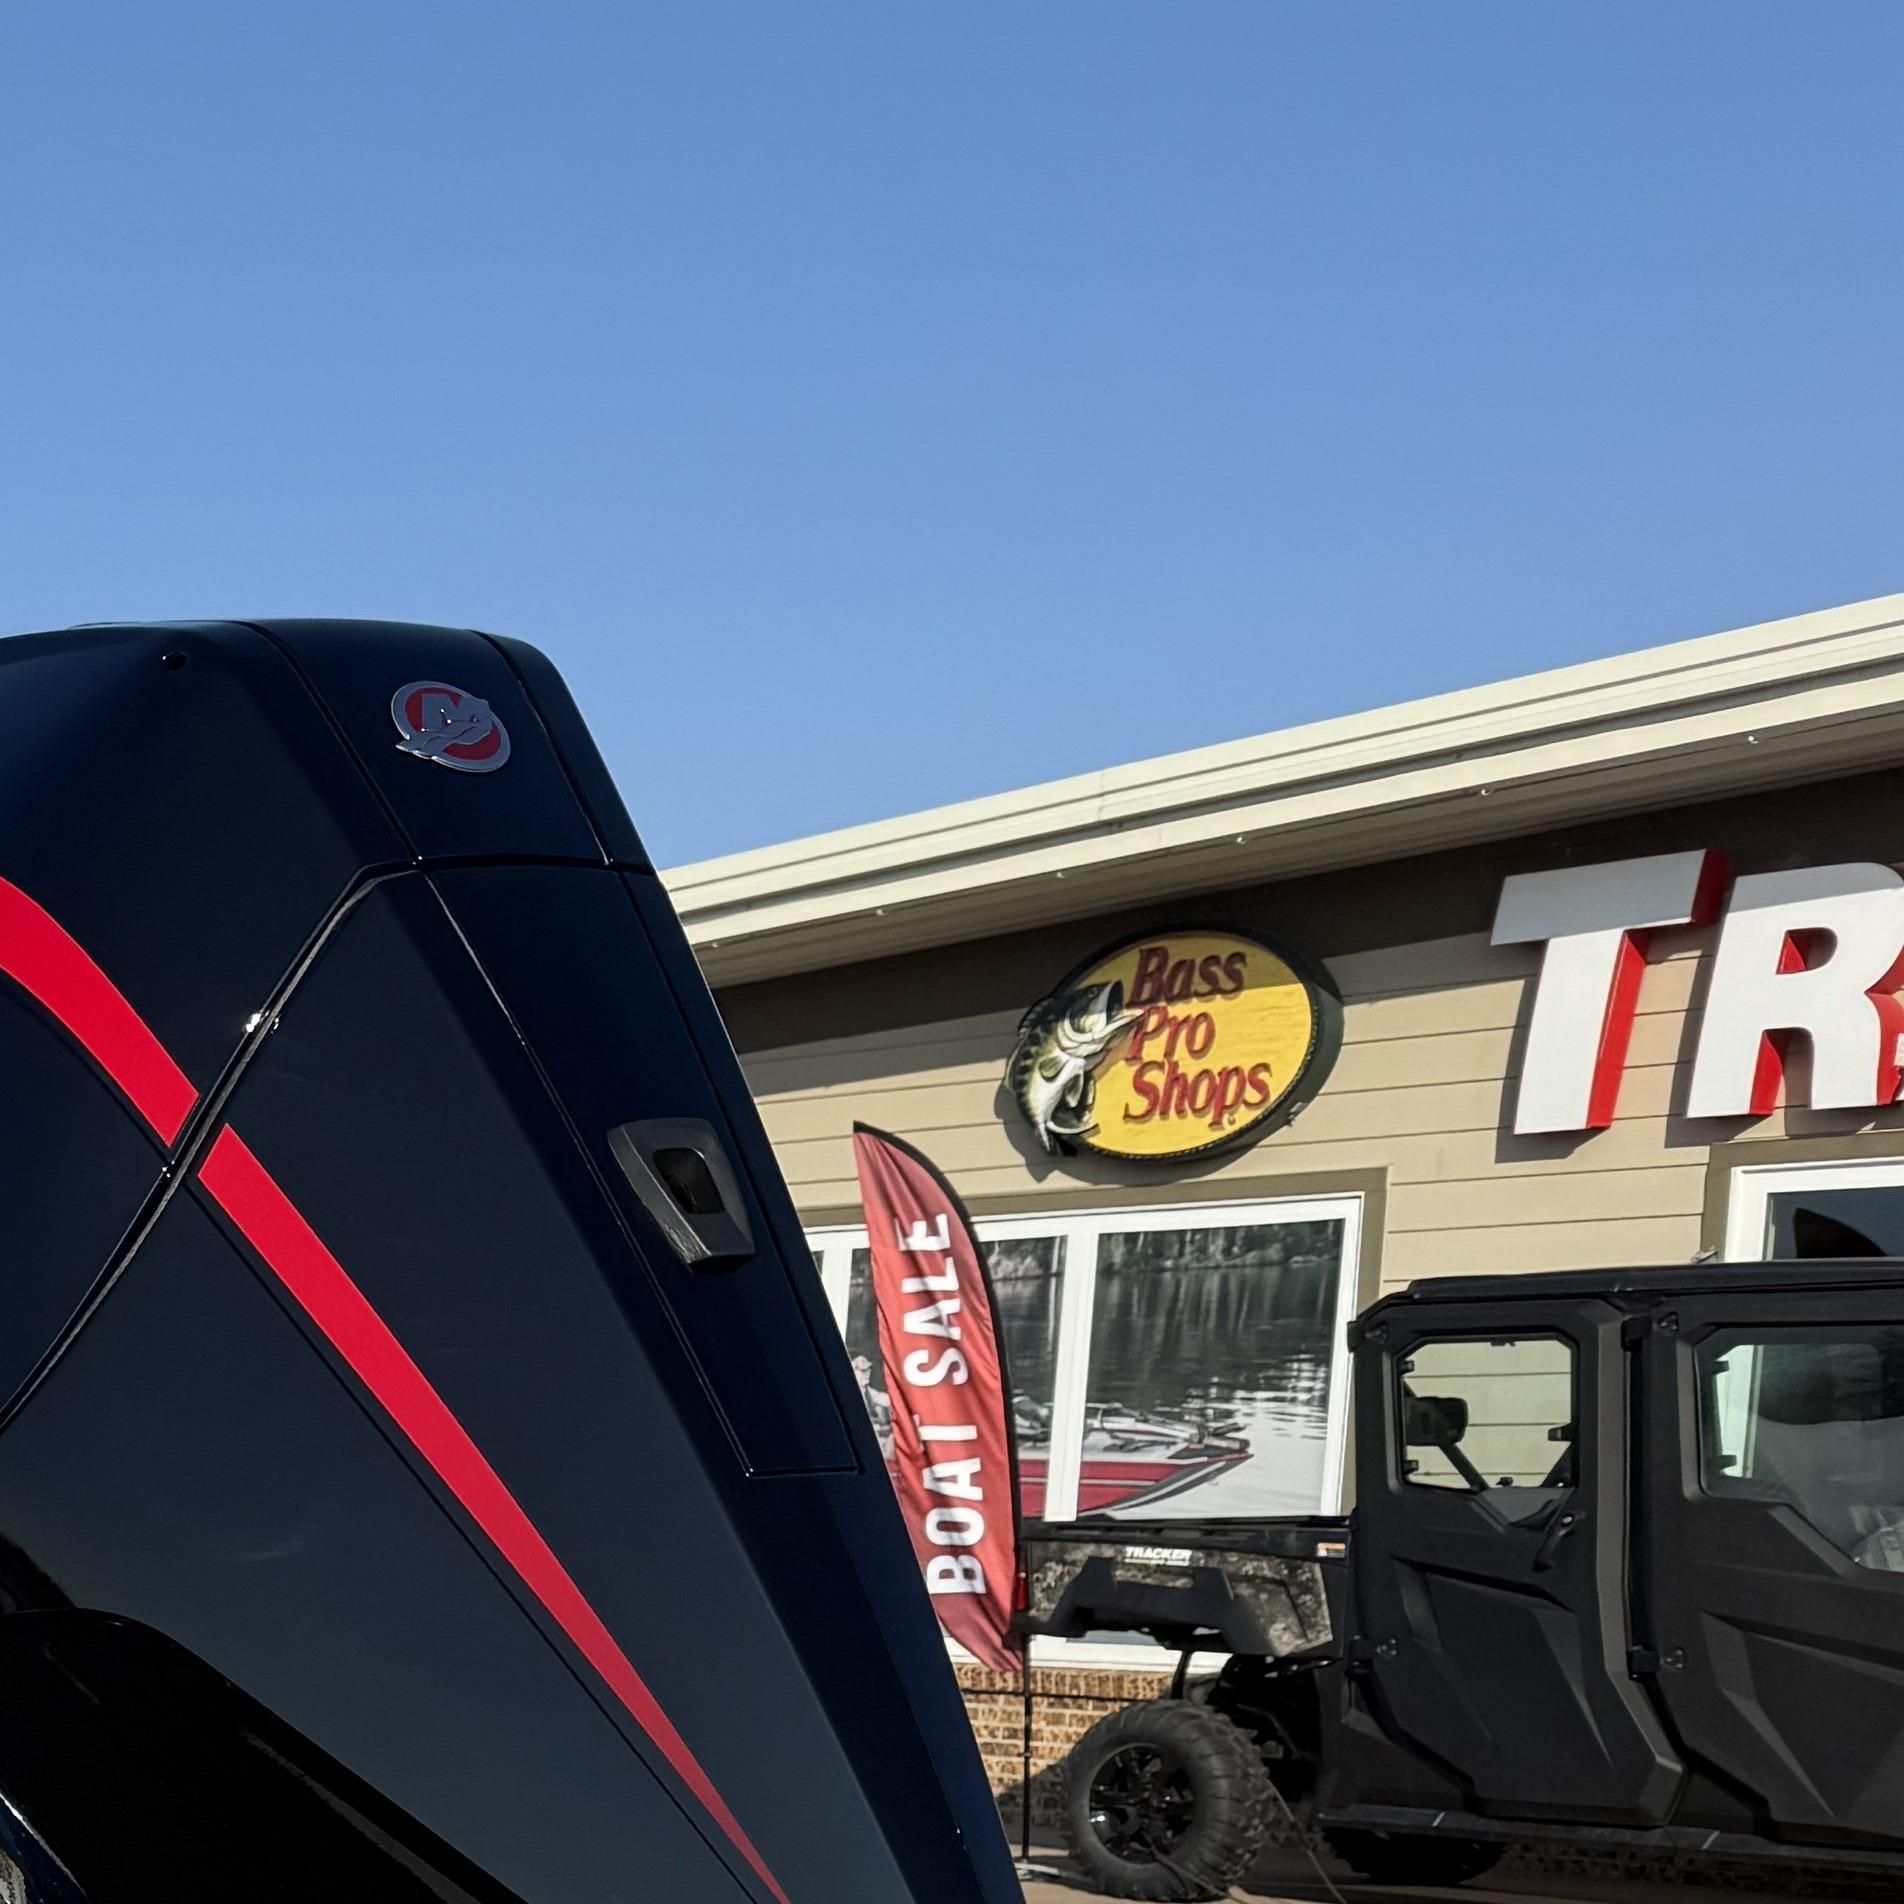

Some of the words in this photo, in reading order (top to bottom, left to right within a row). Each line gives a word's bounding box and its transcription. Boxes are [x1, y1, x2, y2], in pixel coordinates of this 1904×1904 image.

[1125, 947, 1247, 1009] Bass
[1126, 1005, 1216, 1062] Pro
[1124, 1061, 1273, 1130] Shops
[894, 1212, 970, 1388] SALE
[913, 1413, 987, 1595] BOAT
